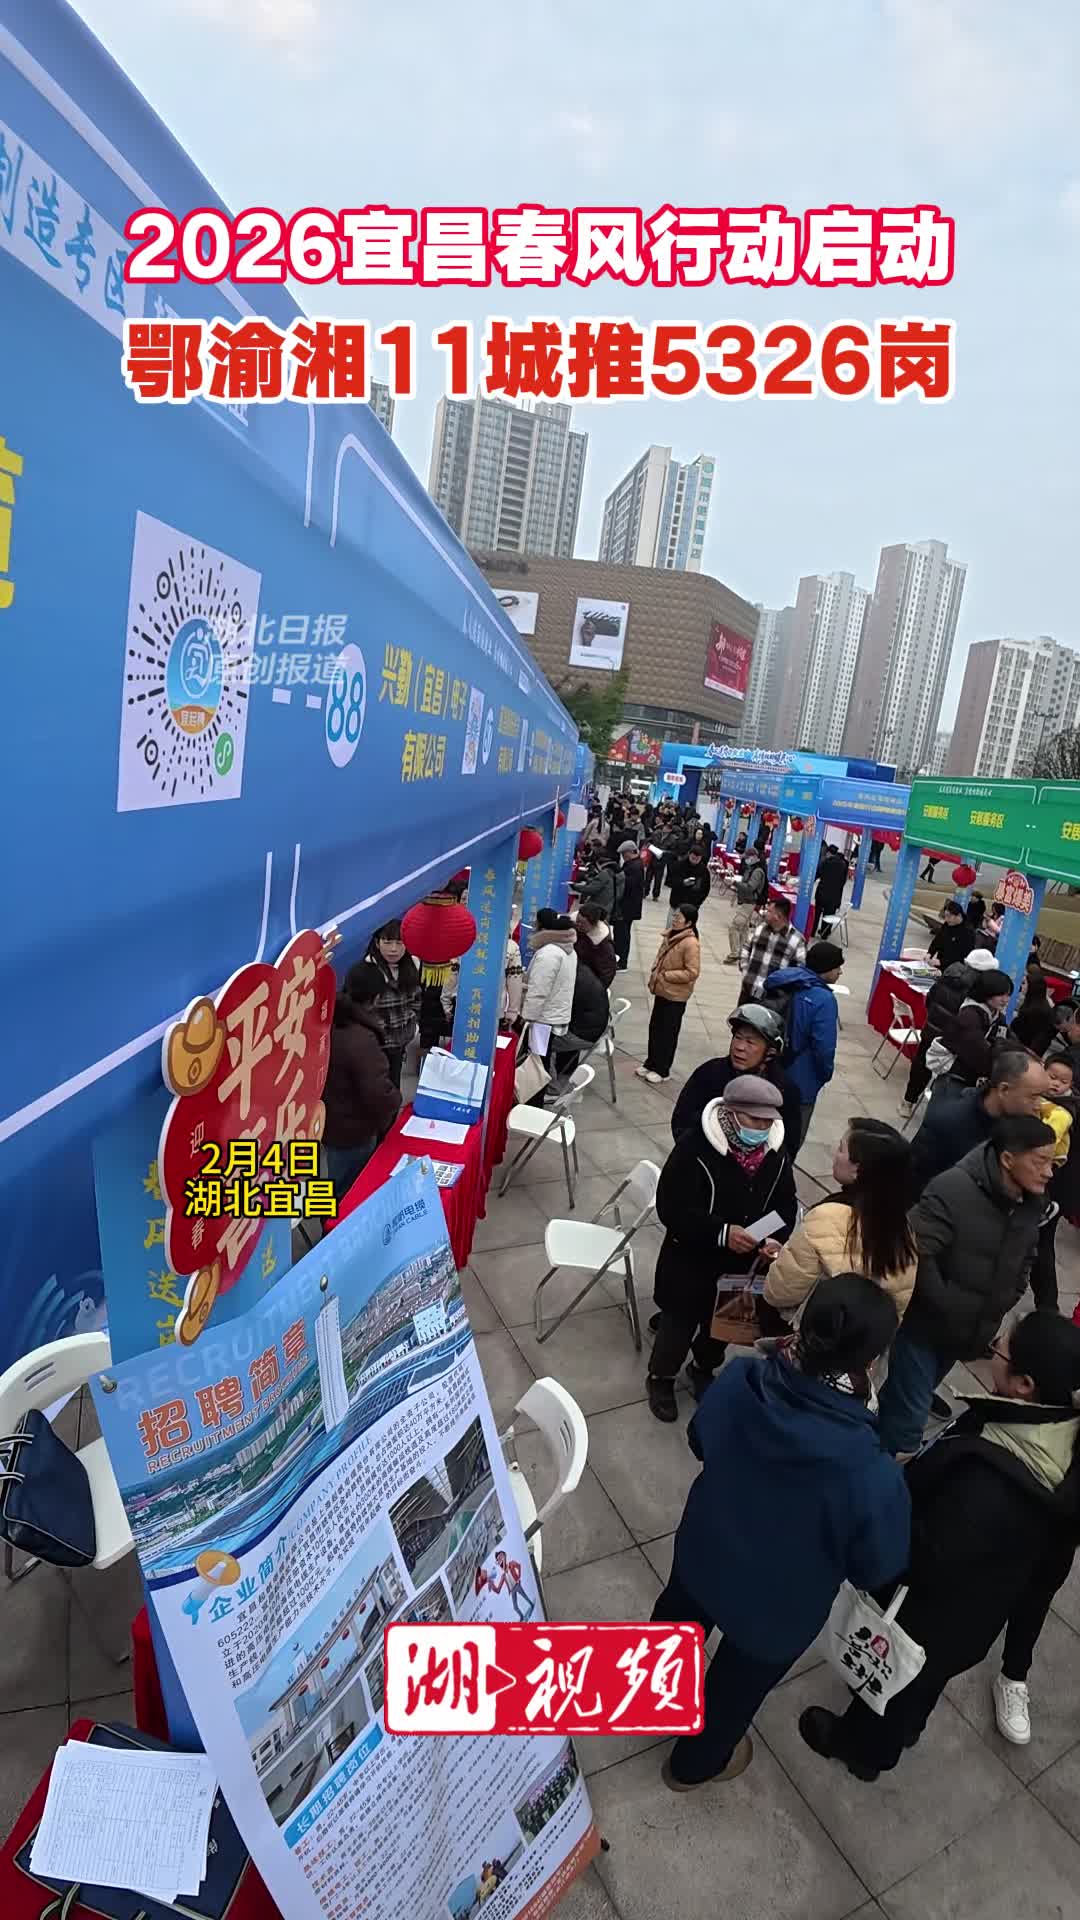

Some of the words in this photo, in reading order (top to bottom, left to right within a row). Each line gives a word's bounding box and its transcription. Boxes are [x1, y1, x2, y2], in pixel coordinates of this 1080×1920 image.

[327, 671, 364, 743] 88
[190, 1120, 205, 1251] 迎春
[137, 1317, 309, 1459] 招聘简章
[146, 1408, 260, 1474] RECRUITMENT
[207, 1534, 290, 1624] 企业简介
[293, 1739, 371, 1837] 长期招聘岗位
